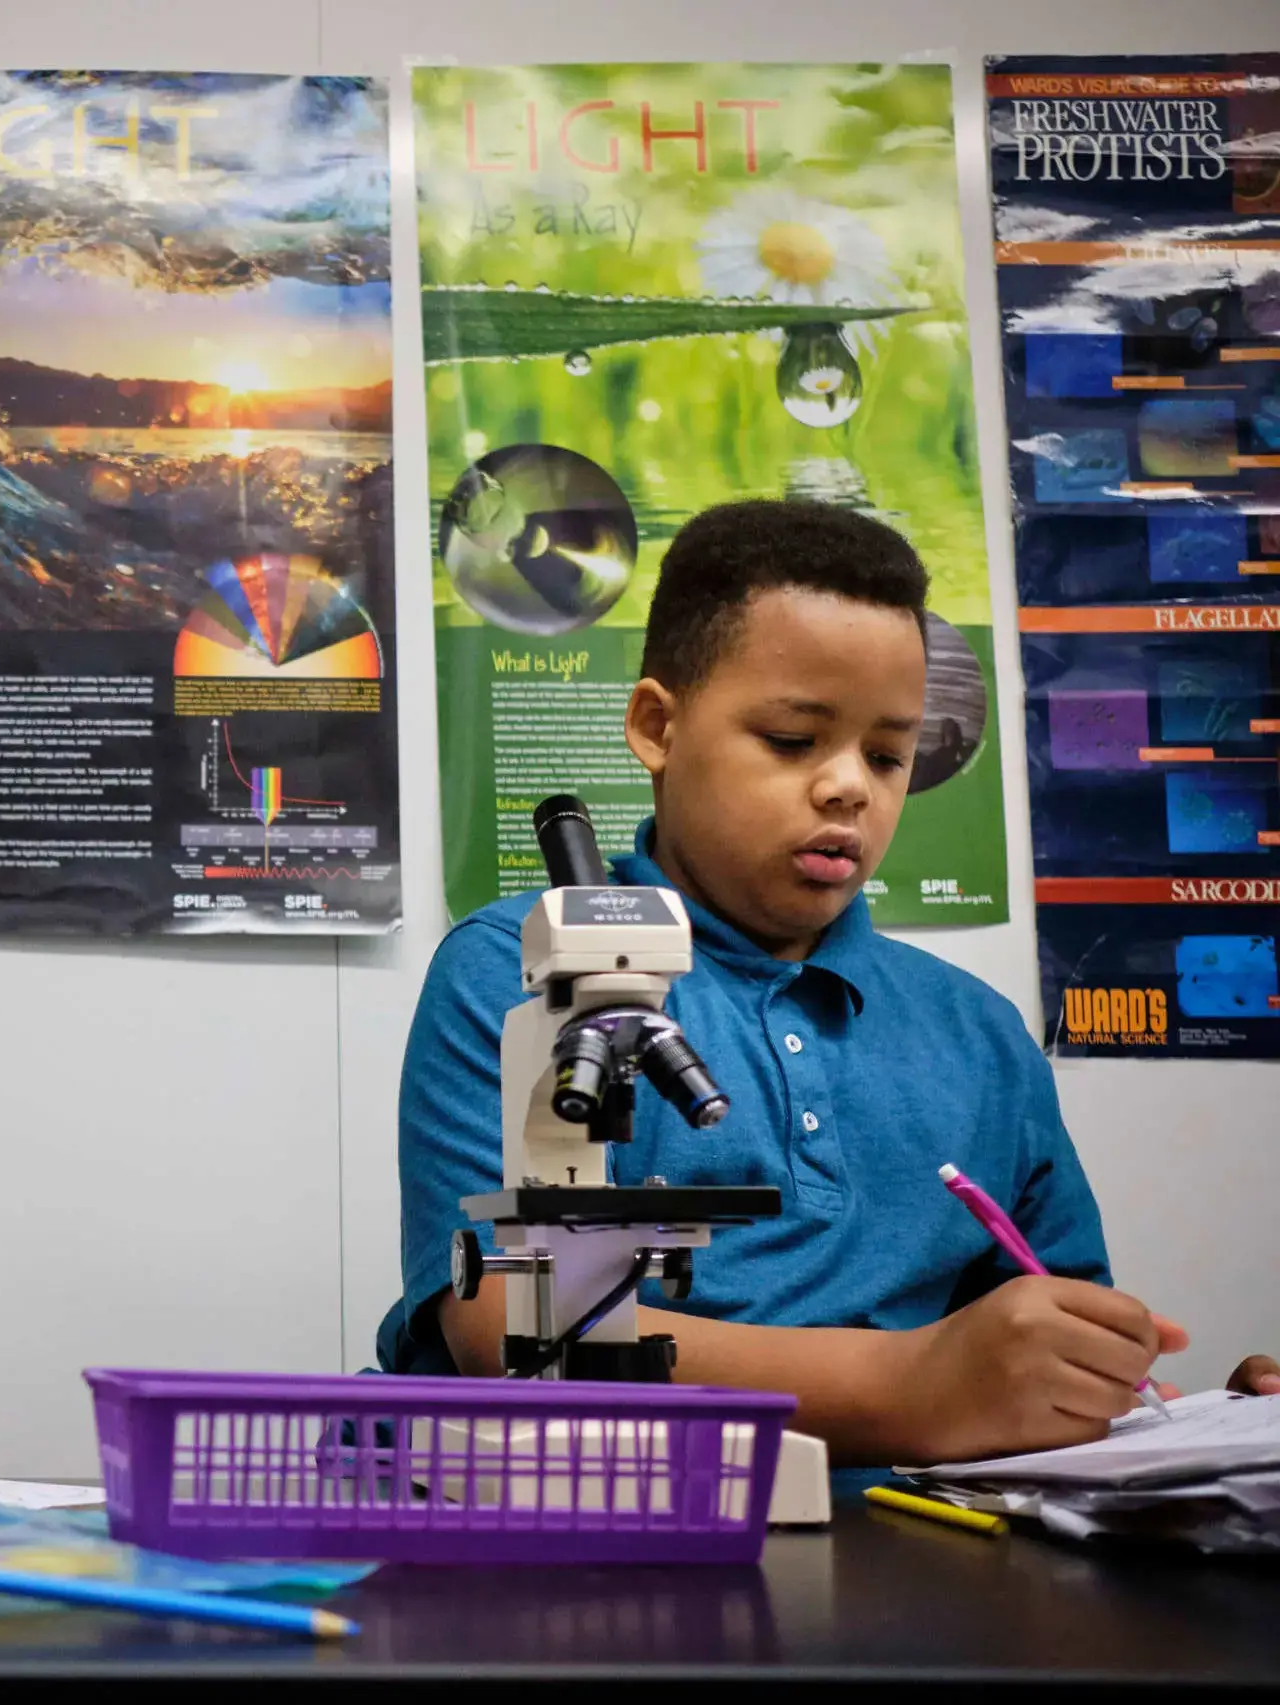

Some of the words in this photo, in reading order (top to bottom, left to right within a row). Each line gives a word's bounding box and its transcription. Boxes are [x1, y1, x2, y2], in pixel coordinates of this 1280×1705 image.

[1078, 76, 1138, 93] VISUAL
[1013, 100, 1222, 132] FRESHWATER
[465, 100, 780, 174] LIGHT
[1014, 133, 1226, 182] PROTISTS
[471, 182, 516, 236] As
[492, 650, 531, 673] What
[534, 656, 546, 672] is
[549, 651, 589, 682] Light?
[1171, 879, 1280, 902] SARCODI
[1064, 988, 1168, 1033] WARD'S
[1067, 1033, 1117, 1046] NATURAL
[1120, 1033, 1167, 1046] SCIENCE
